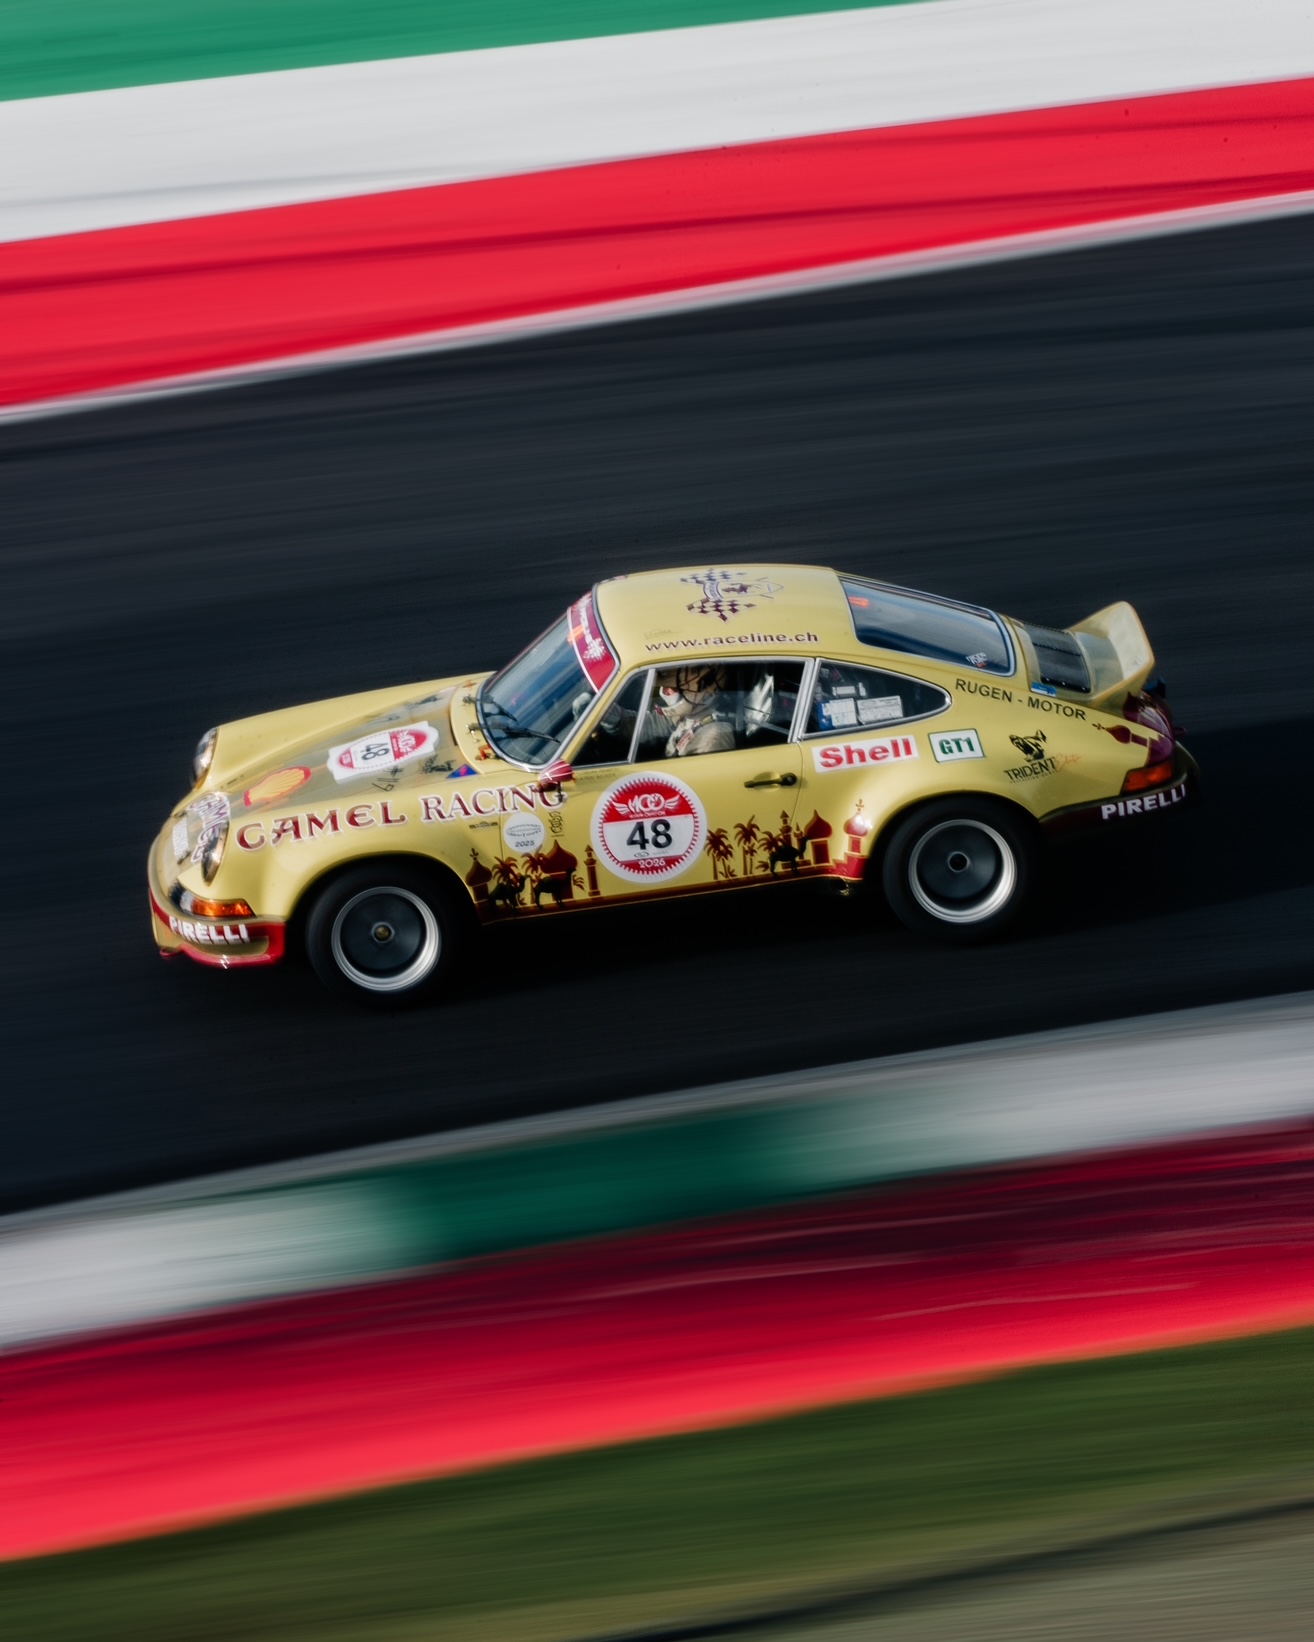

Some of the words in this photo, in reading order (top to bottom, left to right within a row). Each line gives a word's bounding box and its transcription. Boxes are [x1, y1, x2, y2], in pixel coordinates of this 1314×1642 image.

[645, 632, 818, 651] www.raceline.ch
[955, 678, 1012, 703] RUGEN
[1027, 697, 1086, 721] MOTOR
[819, 738, 913, 768] Shell
[939, 737, 975, 755] GT1
[1003, 757, 1056, 781] TRIDENT
[236, 801, 407, 850] CAMEL
[422, 783, 565, 822] RACING
[1101, 783, 1187, 820] PIRELLI
[626, 818, 673, 850] 48
[169, 916, 249, 942] PIRELLI
